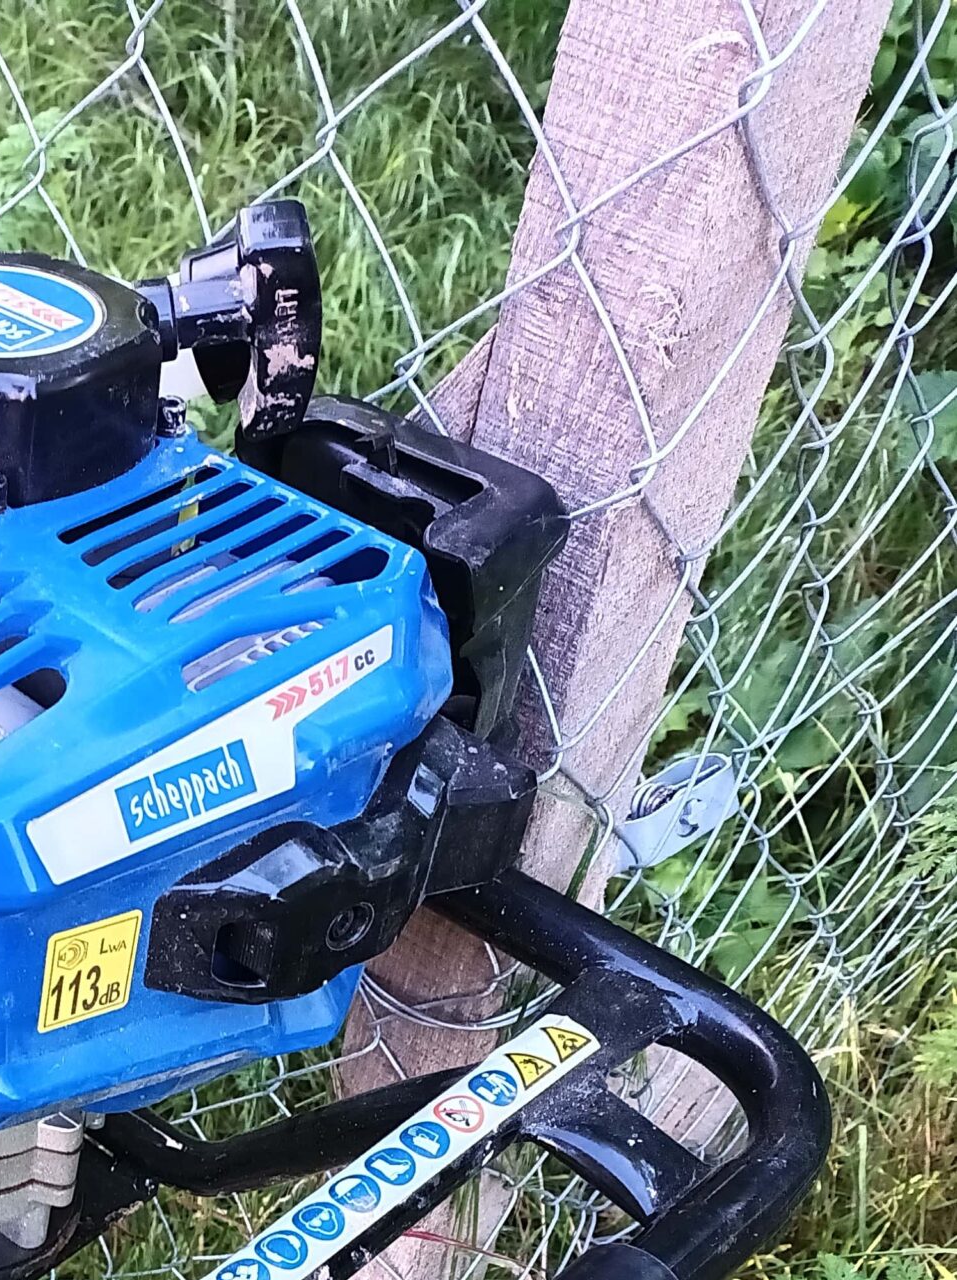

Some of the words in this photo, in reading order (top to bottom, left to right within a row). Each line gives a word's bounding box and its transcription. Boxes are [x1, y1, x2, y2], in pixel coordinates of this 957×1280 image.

[308, 655, 349, 696] 51.7
[354, 649, 375, 671] cc
[130, 745, 244, 828] scheppach
